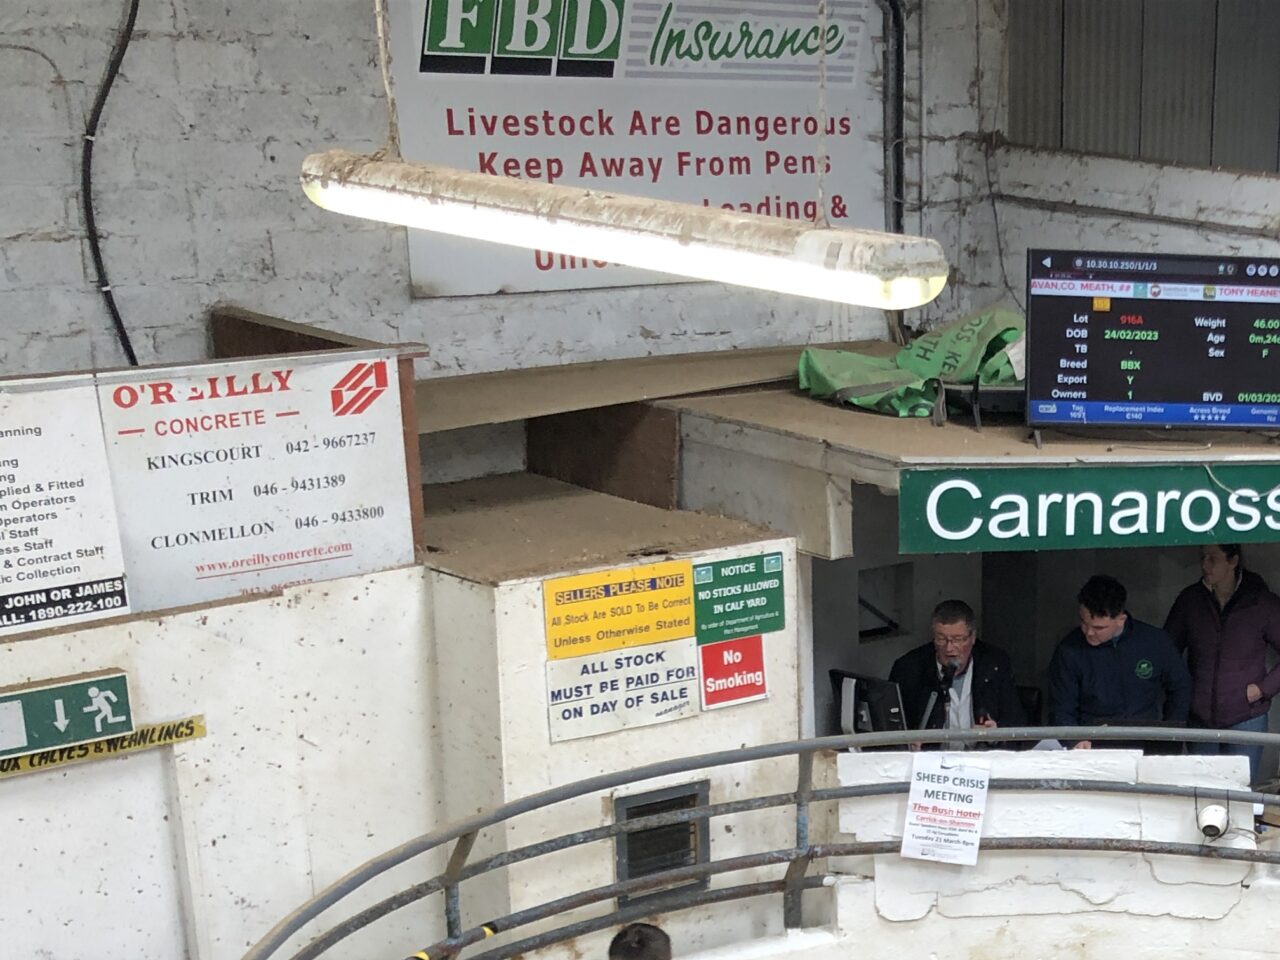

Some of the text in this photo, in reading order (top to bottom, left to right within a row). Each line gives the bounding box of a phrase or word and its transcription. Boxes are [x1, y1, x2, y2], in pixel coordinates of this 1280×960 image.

[439, 0, 846, 66] FBD Insurance
[446, 108, 851, 142] Livestock Are Dangerous
[478, 152, 563, 184] Keep
[579, 152, 663, 182] Away
[678, 152, 751, 177] From
[831, 195, 848, 218] &
[1219, 286, 1244, 296] TONY
[1073, 314, 1088, 324] Lot
[1194, 317, 1280, 329] Weight 46.00
[1066, 329, 1159, 341] DOB 24/02/2023
[1207, 333, 1225, 344] Age
[1075, 345, 1087, 354] TB
[1208, 349, 1225, 358] Sex
[1060, 359, 1087, 369] Breed
[1057, 375, 1134, 386] Export Y
[1051, 390, 1086, 399] Owners
[1203, 392, 1222, 402] BVD
[1104, 405, 1145, 413] Replacement
[155, 409, 266, 437] CONCRETE
[147, 445, 262, 470] KINGSCOURT
[286, 439, 310, 455] 042
[322, 431, 377, 450] 9667237
[35, 484, 45, 493] &
[48, 479, 85, 491] Fitted
[187, 488, 234, 506] TRIM
[253, 483, 278, 497] 046
[291, 473, 347, 492] 9431389
[11, 496, 76, 511] Operators
[9, 527, 39, 539] Staff
[151, 521, 276, 550] CLONMELLON
[295, 515, 319, 530] 046
[331, 505, 385, 525] 9433800
[24, 539, 53, 551] Staff
[4, 546, 104, 568] & Contract Staff
[195, 541, 353, 573] www.oreillyconcrete.com
[16, 565, 81, 581] Collection
[721, 563, 756, 577] NOTICE
[5, 580, 123, 609] JOHN OR JAMES
[556, 575, 684, 605] SELLERS PLEASE NOTE
[698, 579, 780, 600] NO STICKS ALLOWED
[29, 596, 122, 620] 1890-222-100
[551, 597, 691, 627] All Stock Are SOLD To Be Correct
[713, 597, 767, 614] IN CALF YARD
[554, 617, 690, 648] Unless Otherwise Stated
[580, 651, 666, 676] ALL STOCK
[723, 649, 741, 665] No
[550, 666, 696, 702] MUST BE PAID FOR
[706, 670, 763, 693] Smoking
[562, 706, 583, 720] ON
[590, 700, 618, 715] DAY
[625, 695, 644, 709] OF
[650, 687, 688, 704] SALE
[28, 743, 89, 768] CALVES
[916, 772, 985, 790] SHEEP CRISIS
[924, 789, 973, 804] MEETING
[913, 803, 929, 811] The
[956, 809, 981, 818] Hotel
